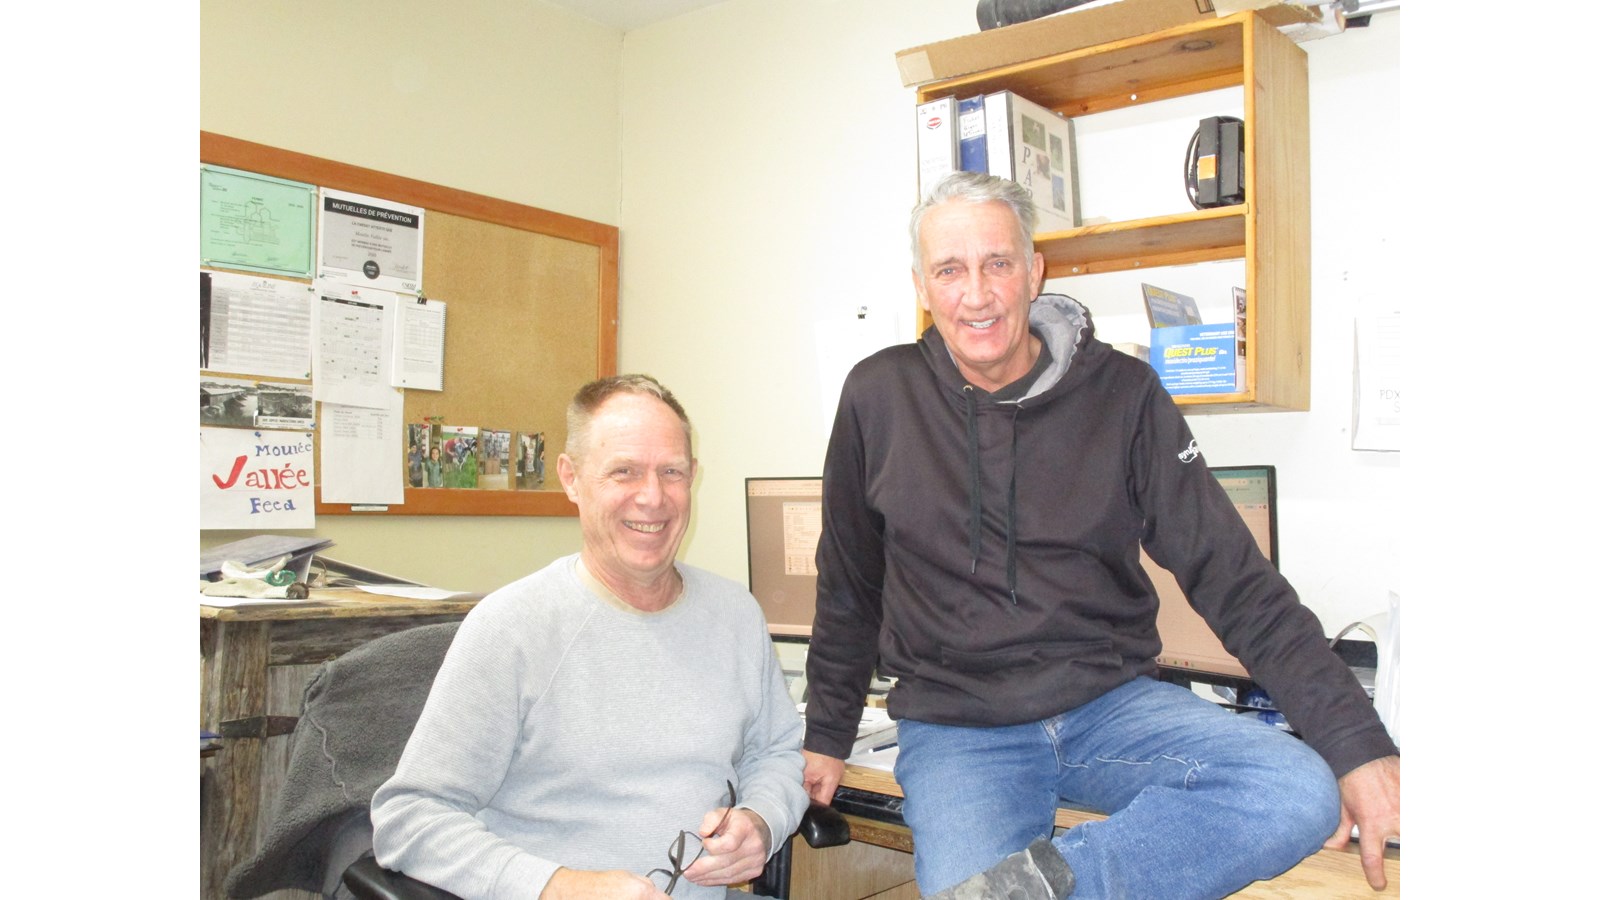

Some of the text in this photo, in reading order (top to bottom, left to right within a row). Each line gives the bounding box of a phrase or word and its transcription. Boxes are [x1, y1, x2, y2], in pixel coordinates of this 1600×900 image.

[332, 202, 412, 224] MUTUELLES DE PRÉVENTION
[1164, 347, 1194, 359] QUEST
[212, 455, 310, 490] Vallée
[250, 498, 296, 515] Feed
